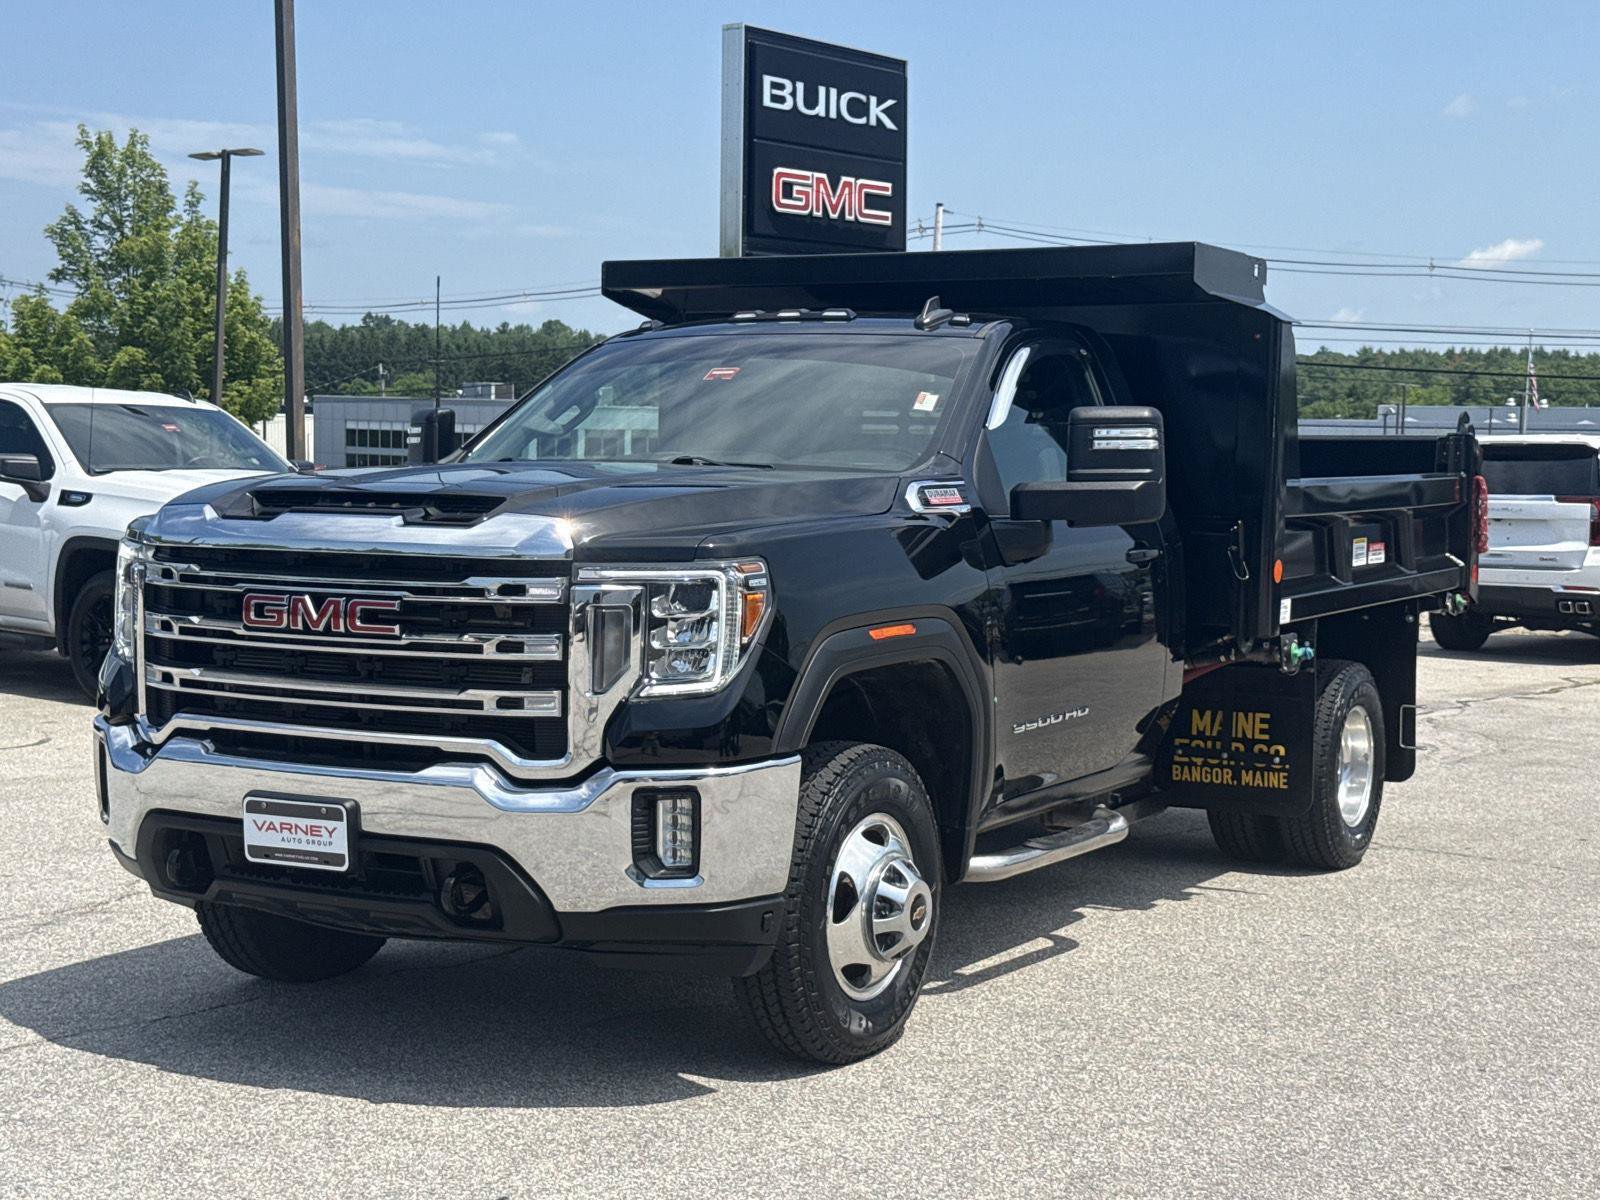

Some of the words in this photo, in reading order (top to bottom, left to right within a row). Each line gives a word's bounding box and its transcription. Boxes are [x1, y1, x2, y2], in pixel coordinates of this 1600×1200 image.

[762, 74, 898, 131] BUICK
[772, 166, 893, 227] GMC
[926, 489, 958, 498] DURAMAX
[242, 593, 401, 637] GMC
[1171, 764, 1238, 786] BANGOR,
[1241, 769, 1289, 789] MAINE
[252, 819, 338, 839] VARNEY
[280, 836, 303, 845] AUTO
[305, 838, 334, 848] GROUP
